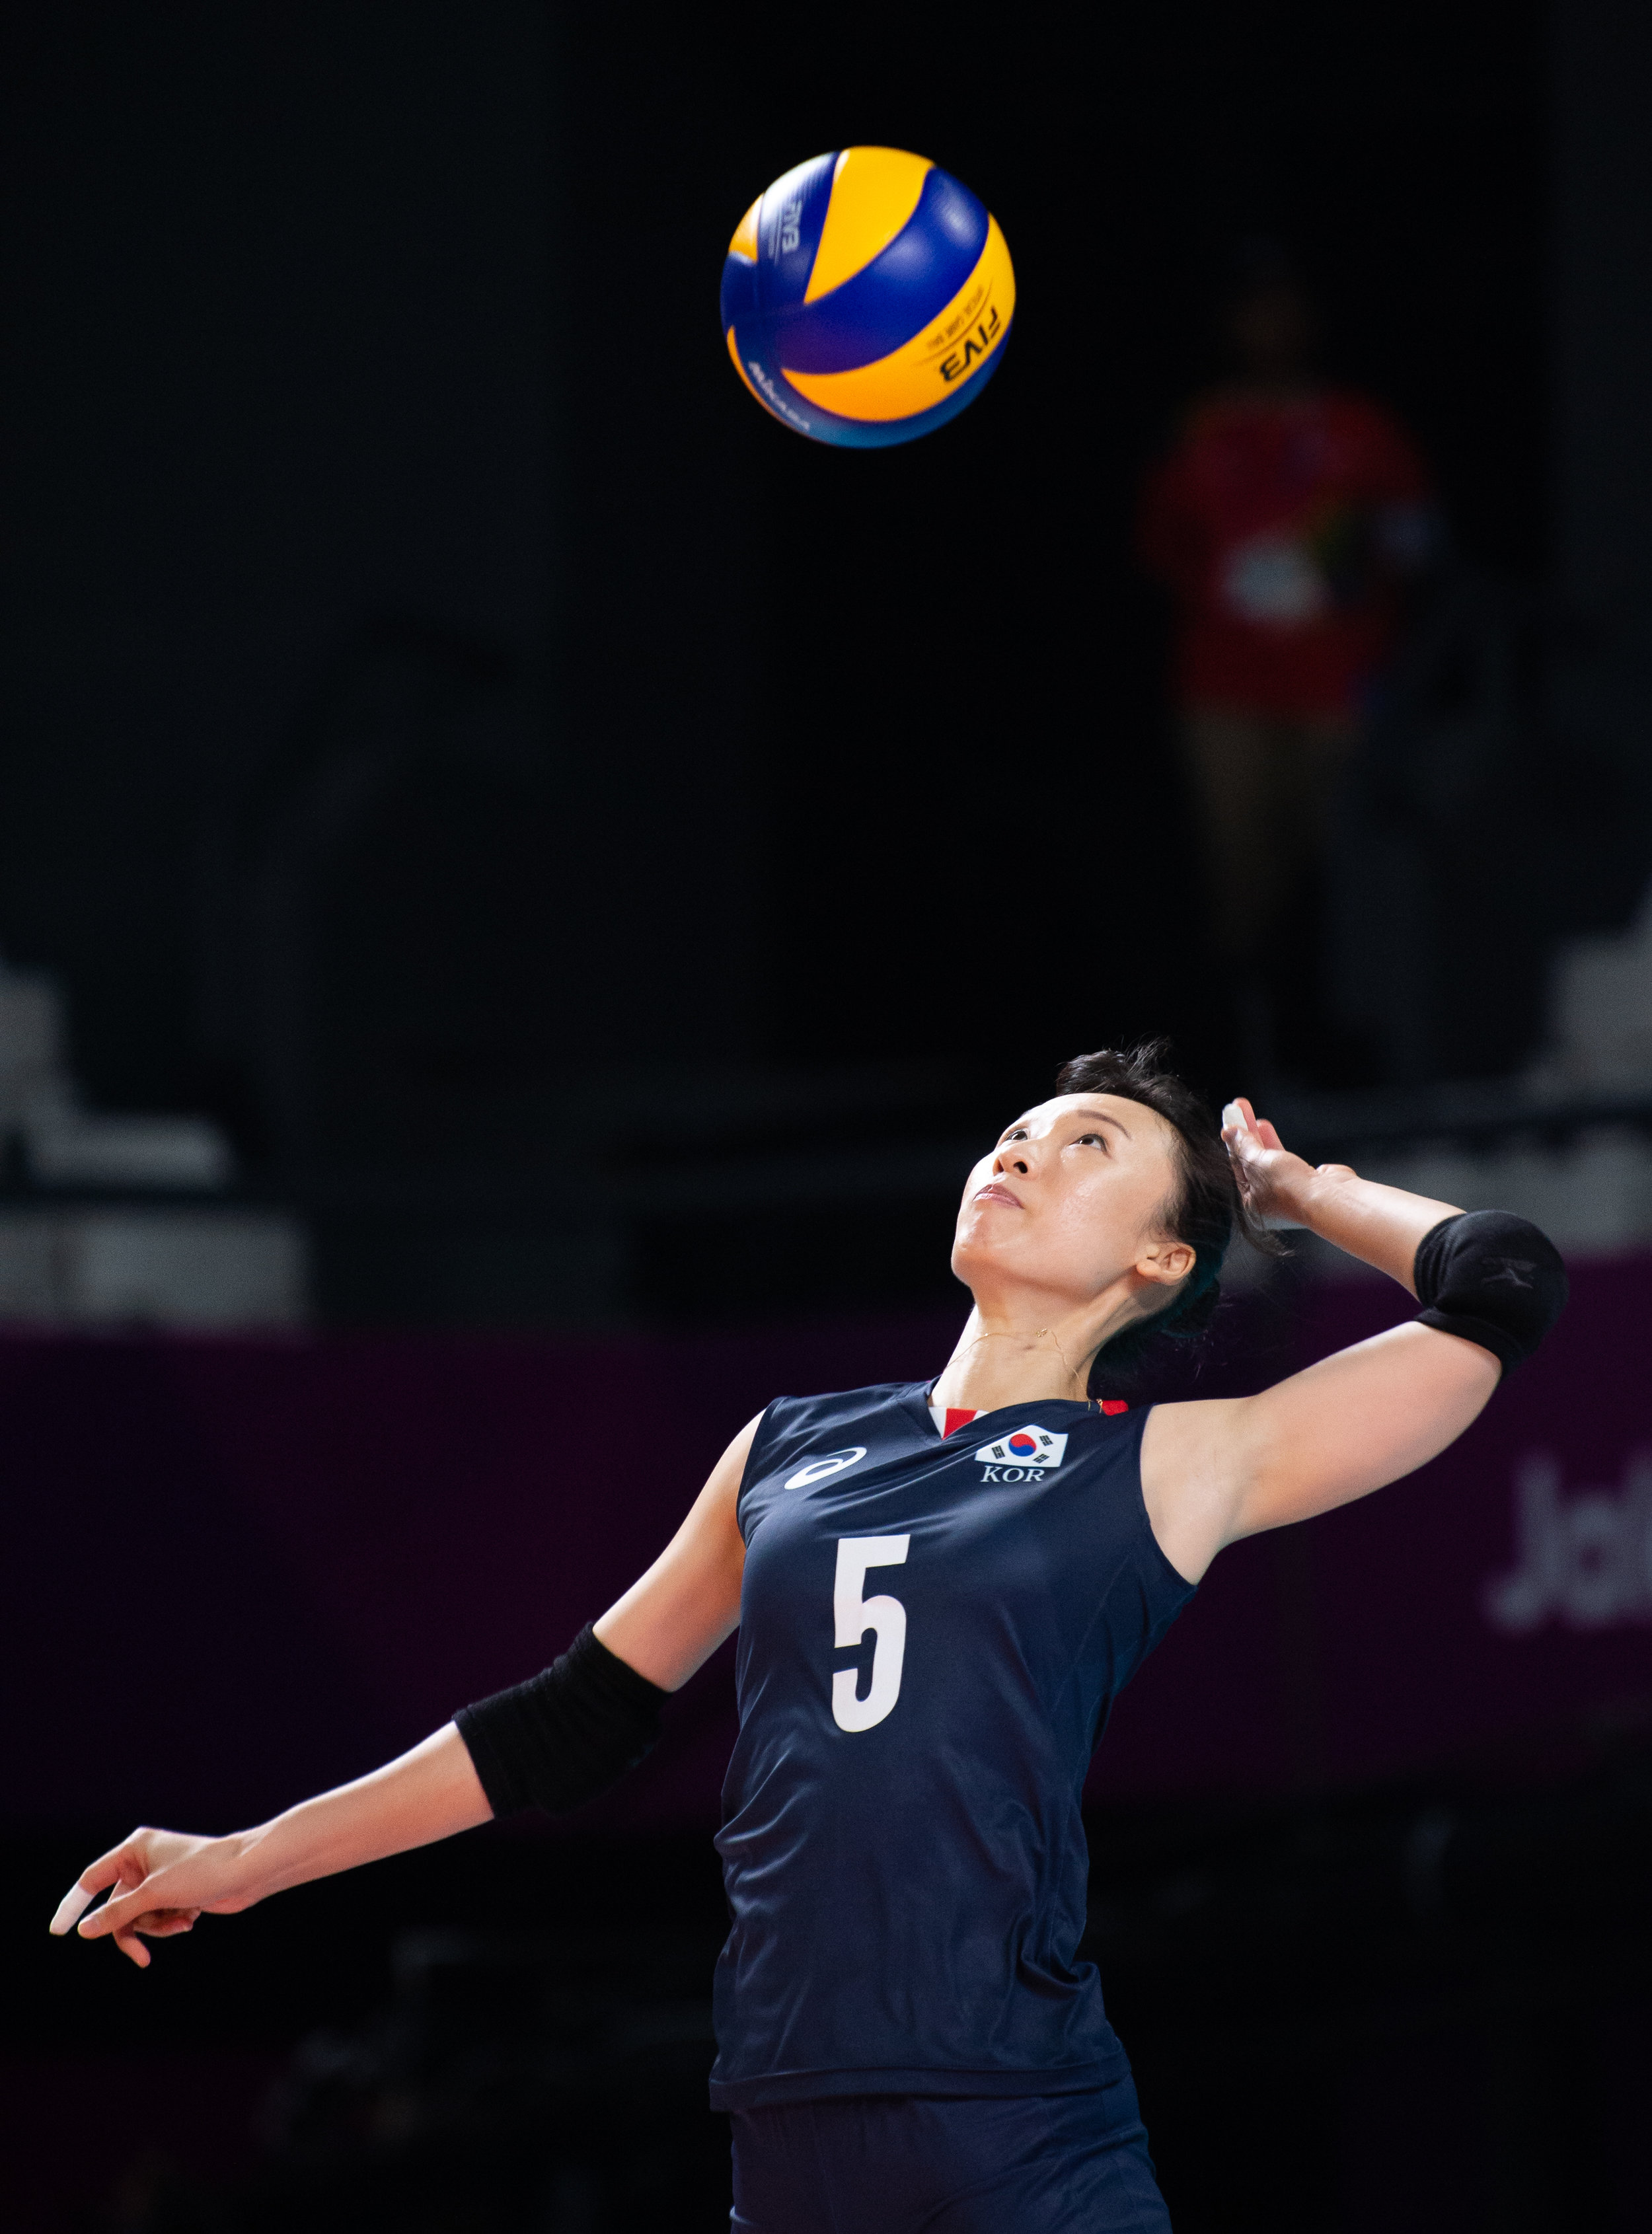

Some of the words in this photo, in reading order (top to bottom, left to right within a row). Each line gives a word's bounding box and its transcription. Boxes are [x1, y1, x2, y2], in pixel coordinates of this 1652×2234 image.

[940, 307, 1002, 383] FIVB
[980, 1466, 1045, 1483] KOR
[832, 1534, 911, 1732] 5
